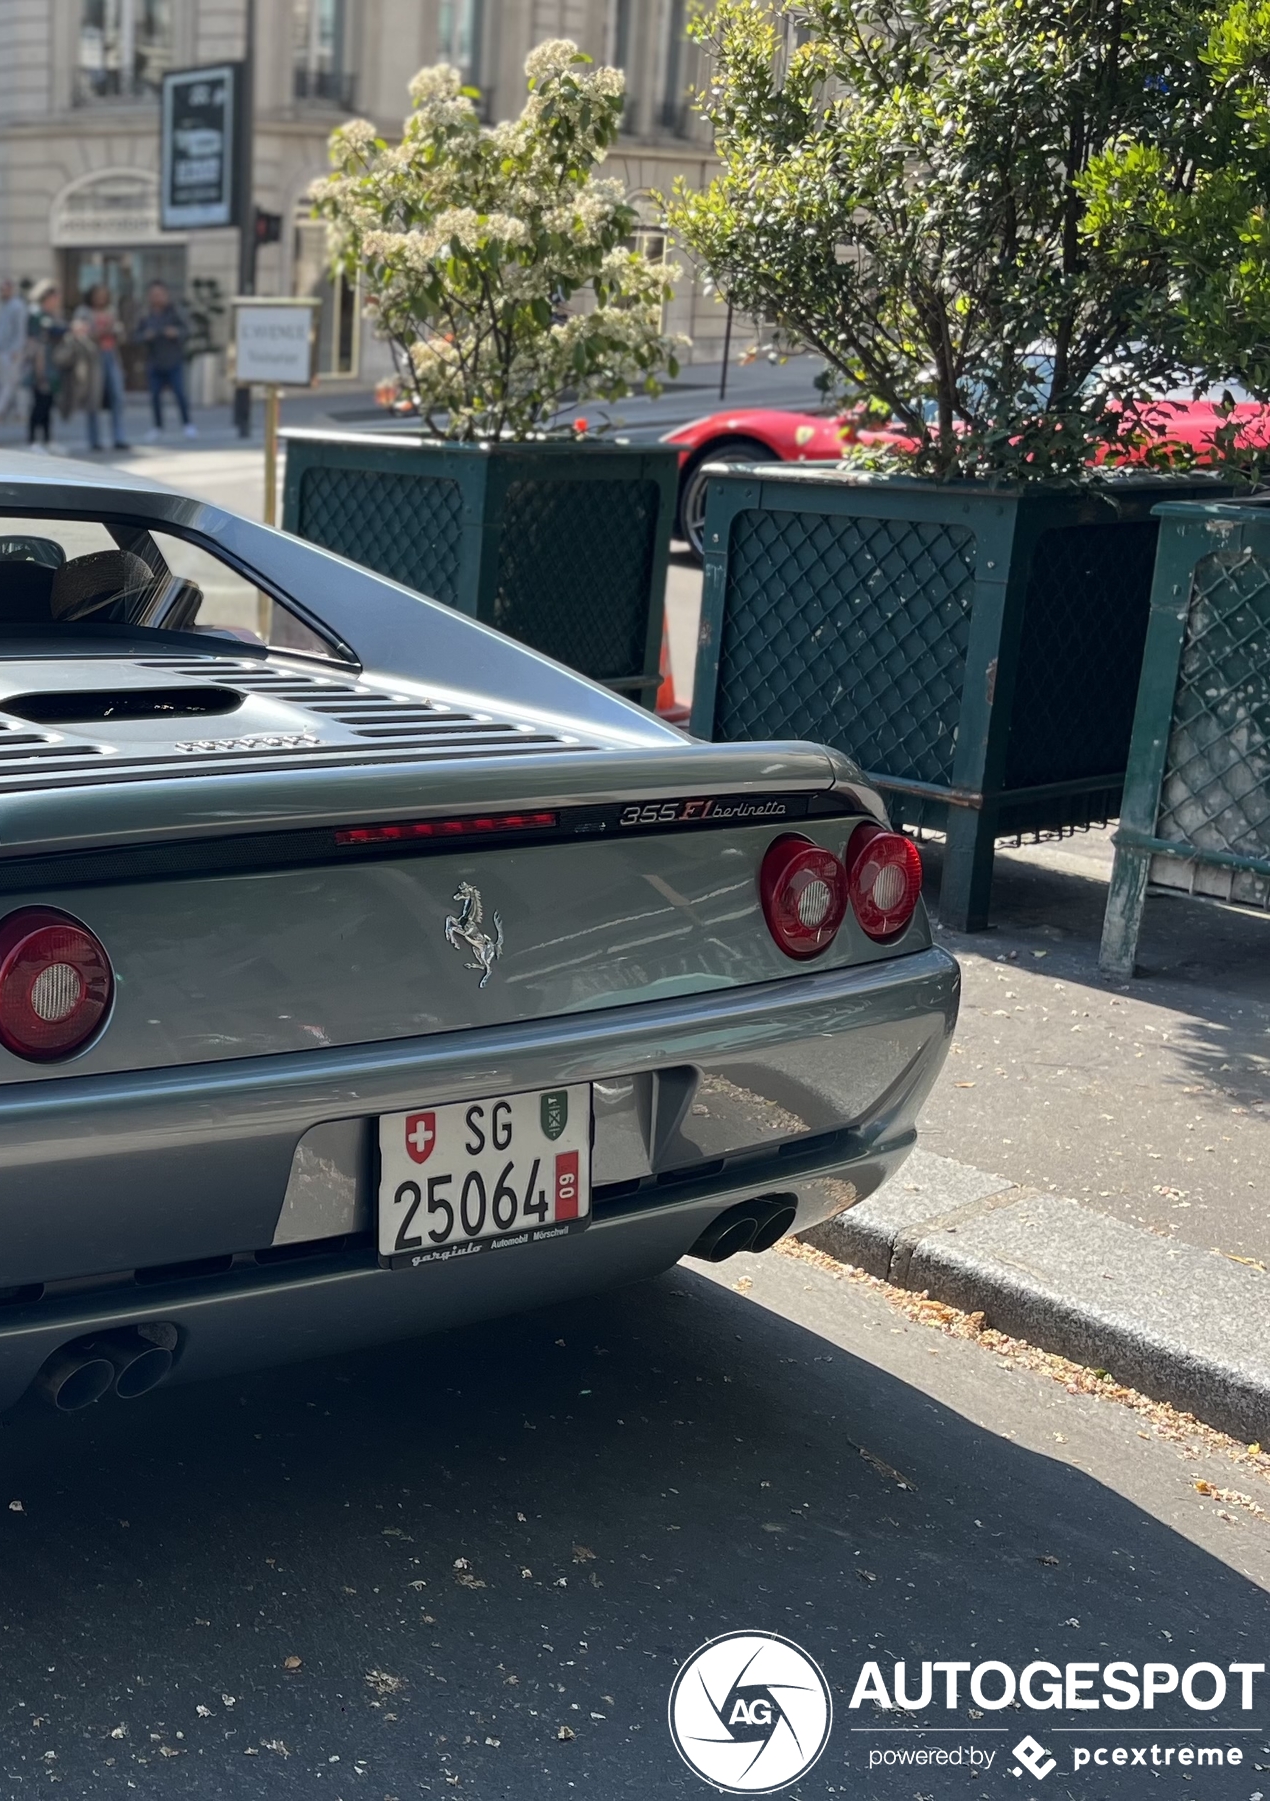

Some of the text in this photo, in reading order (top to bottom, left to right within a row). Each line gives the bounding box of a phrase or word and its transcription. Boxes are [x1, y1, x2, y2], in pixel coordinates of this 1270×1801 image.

[620, 800, 786, 826] 355 F1 berlinetta
[465, 1101, 512, 1155] SG
[394, 1159, 548, 1251] 25064
[411, 1226, 569, 1267] gargiulo Automobil Mörschwil
